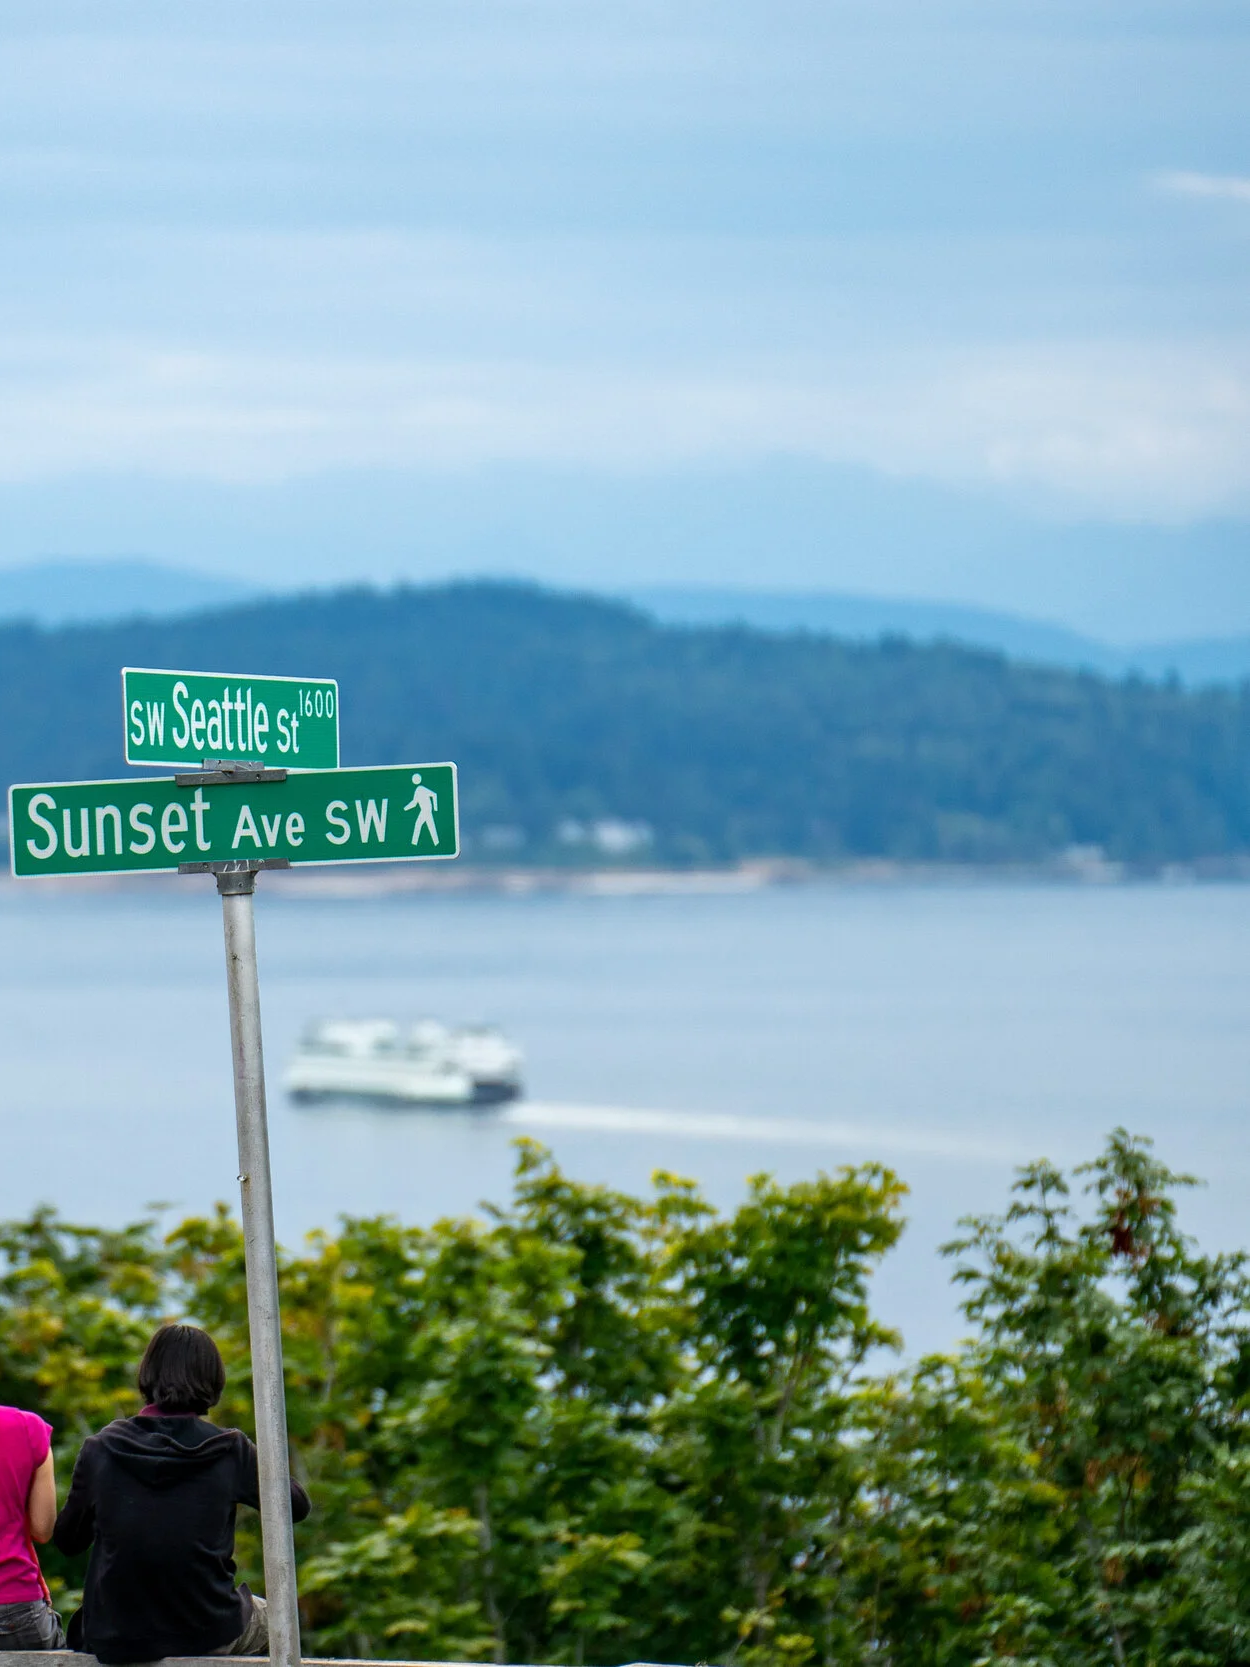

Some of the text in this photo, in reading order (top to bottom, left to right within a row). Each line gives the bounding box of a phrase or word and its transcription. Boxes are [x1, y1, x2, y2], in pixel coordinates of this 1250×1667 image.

[130, 681, 299, 753] SW Seattle St
[299, 689, 334, 719] 1600
[26, 788, 389, 859] Sunset Ave SW
